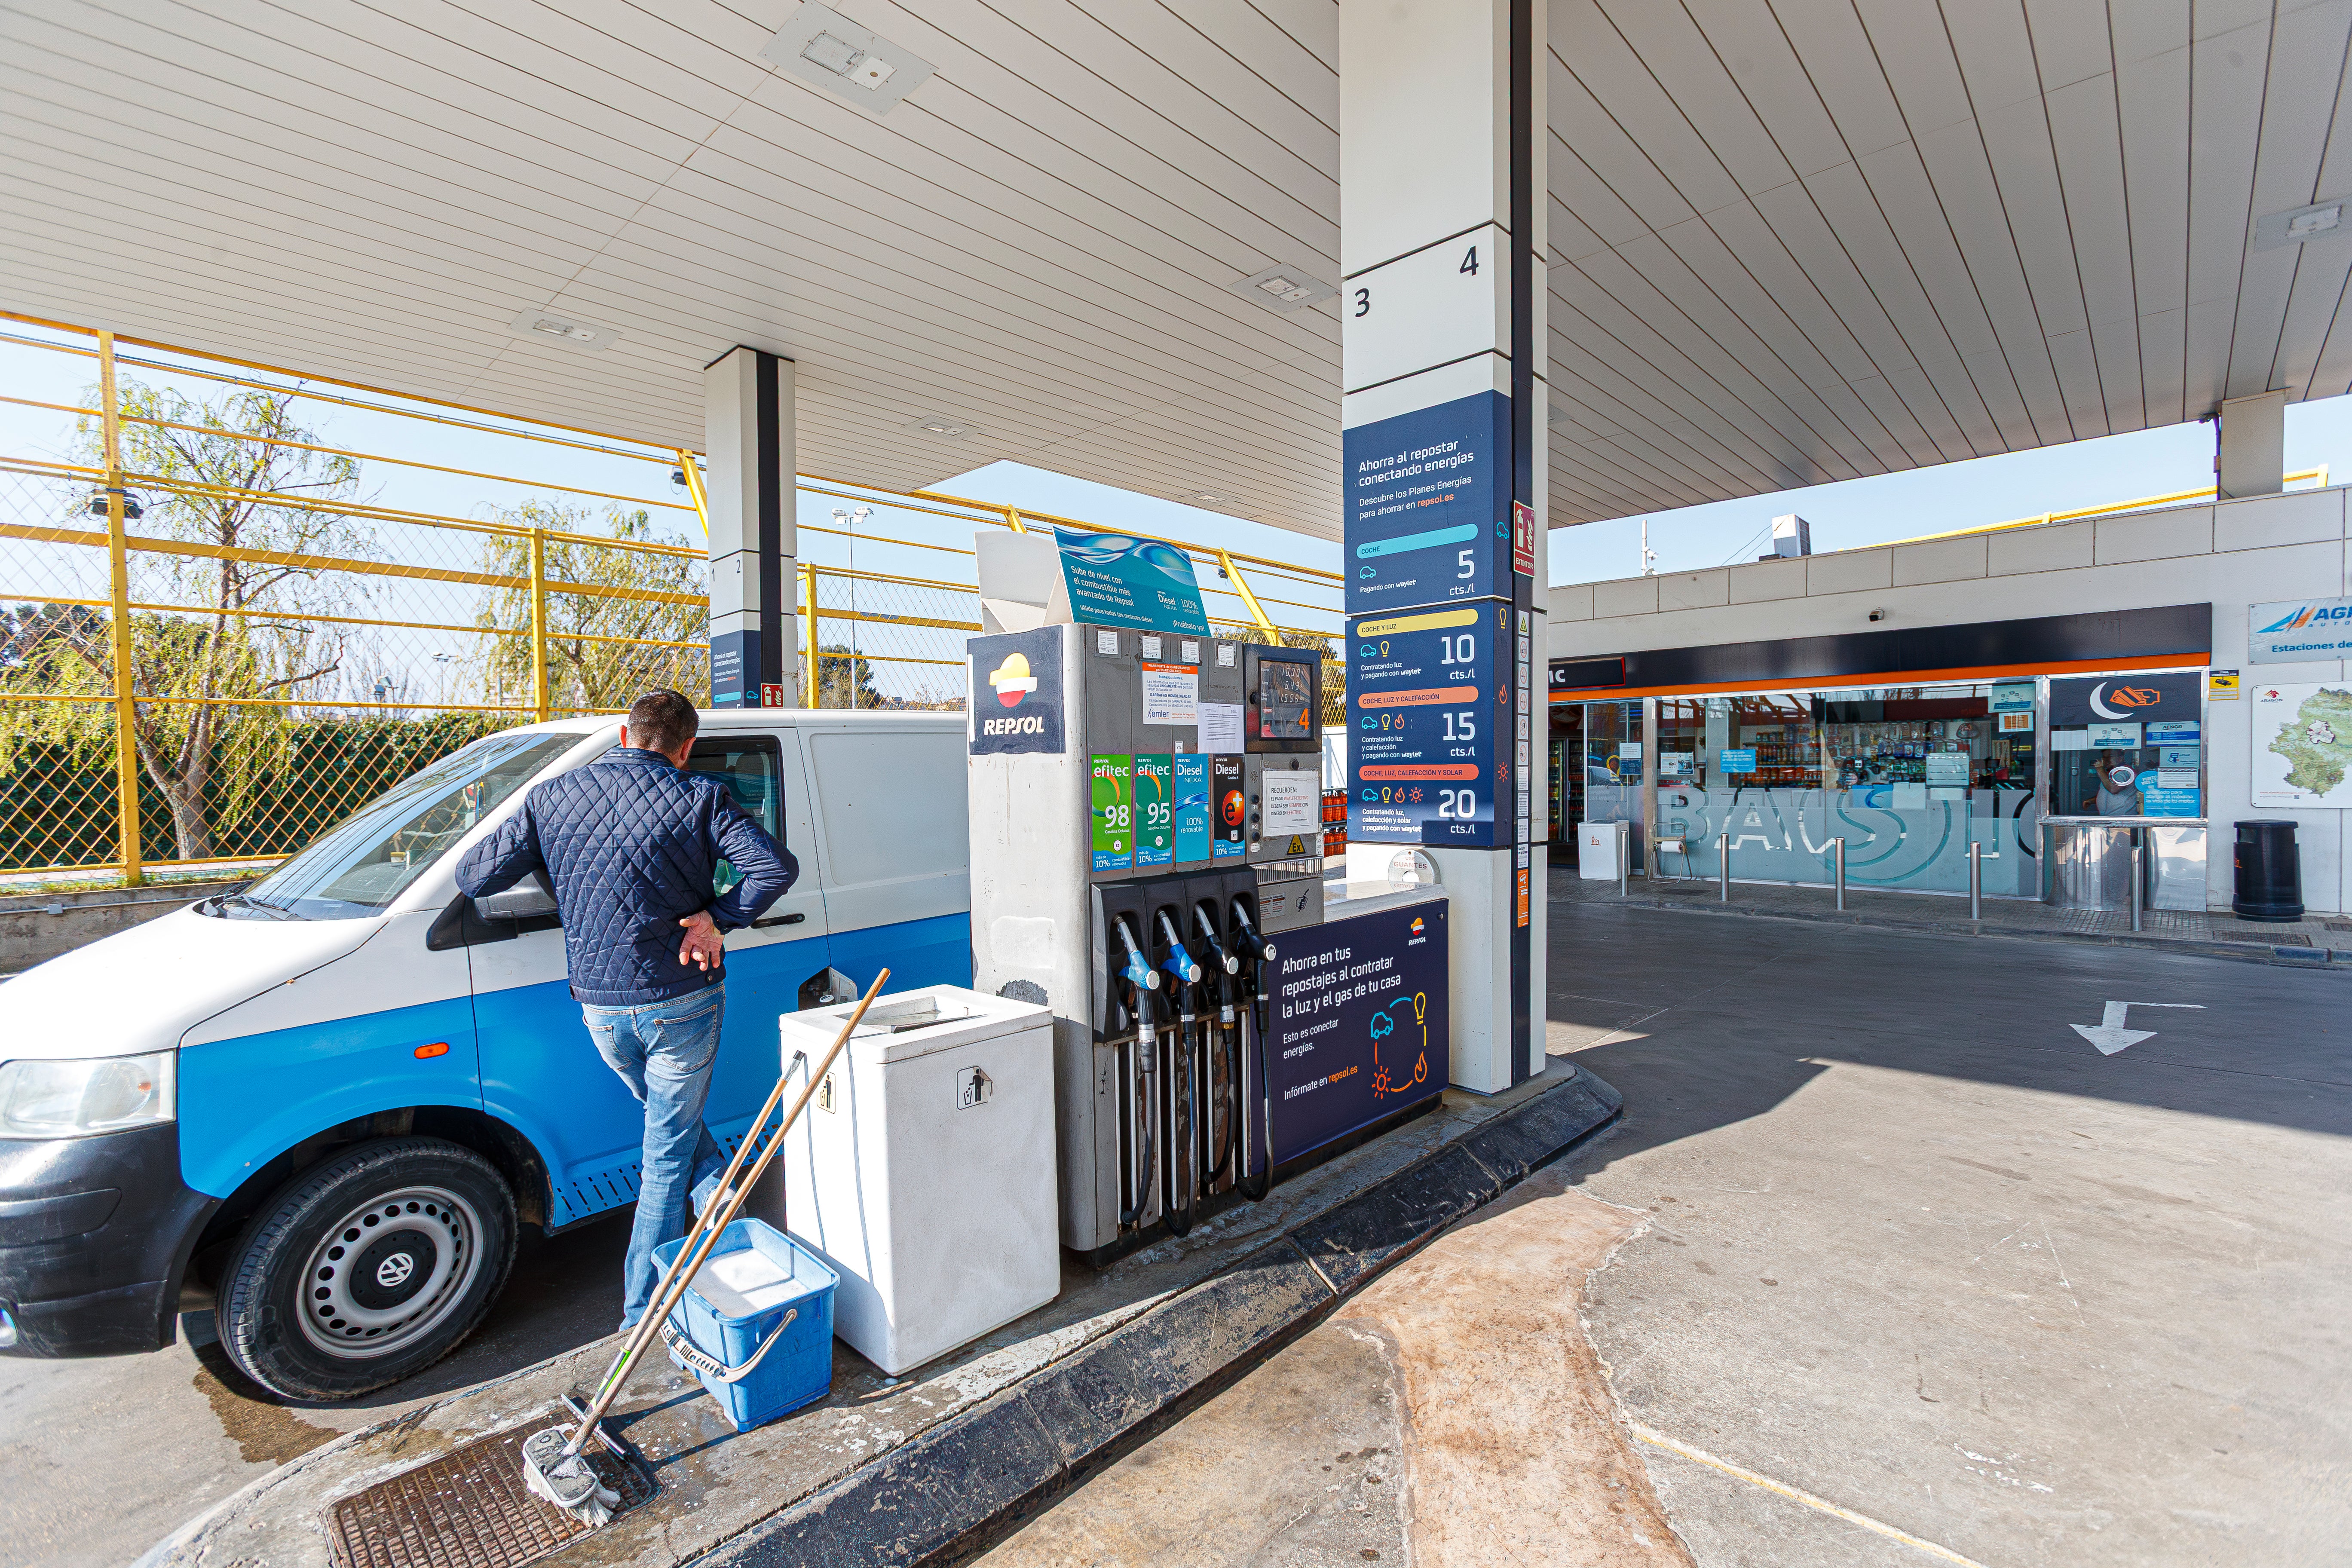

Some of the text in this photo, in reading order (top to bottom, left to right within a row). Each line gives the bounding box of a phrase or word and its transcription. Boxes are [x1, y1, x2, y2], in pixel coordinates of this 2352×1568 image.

[1459, 245, 1479, 276] 4
[1355, 288, 1370, 318] 3
[1359, 441, 1458, 472] Ahorra al repostar
[1359, 450, 1474, 487] conectando energías
[1359, 475, 1472, 506] Descubre los Planes Energías
[1360, 492, 1454, 521] para ahorrar en repsol.es
[1361, 545, 1380, 554] COCHE
[736, 560, 741, 573] 2
[1457, 549, 1475, 579] 5
[1516, 557, 1534, 570] EXTINTOR
[712, 568, 715, 582] 1
[1071, 565, 1087, 576] Sube
[1087, 568, 1095, 578] de
[1096, 571, 1111, 582] nivel
[1074, 576, 1131, 596] el combustible más
[1360, 584, 1383, 594] Pagando
[1395, 579, 1417, 589] waylet
[1449, 583, 1475, 596] cts./l
[1076, 588, 1135, 607] avanzado de Repsol
[1158, 594, 1198, 609] Diesel 100%
[1079, 604, 1093, 612] Válido
[1173, 620, 1197, 631] ¡Pruébalo
[1362, 625, 1380, 633] COCHE
[1441, 634, 1475, 665] 10
[2272, 640, 2352, 652] Estaciones de
[1361, 662, 1393, 671] Contratando
[1365, 670, 1388, 679] pagando
[1400, 668, 1421, 677] waylet
[1450, 668, 1475, 680] cts./l
[1400, 692, 1439, 702] CALEFACCIÓN
[983, 716, 1044, 735] REPSOL
[1299, 708, 1309, 730] 4
[1443, 712, 1475, 741] 15
[1450, 747, 1475, 757] cts./l
[1094, 765, 1129, 777] efitec
[1138, 764, 1170, 775] efitec
[1177, 764, 1202, 776] Diesel
[1216, 763, 1239, 775] Diesel
[1397, 767, 1436, 776] CALEFACCIÓN
[1439, 790, 1476, 818] 20
[1105, 805, 1129, 828] 98
[1148, 802, 1170, 824] 95
[1186, 817, 1203, 826] 100%
[1451, 824, 1475, 834] cts./l
[1292, 842, 1301, 852] Ex
[1096, 859, 1110, 868] 10%
[1139, 855, 1152, 863] 10%
[1408, 936, 1426, 946] REPSOL
[1282, 947, 1351, 975] Ahorra en tus
[1282, 956, 1394, 997] repostajes al contratar
[1282, 974, 1401, 1019] la luz y el gas de tu casa
[1283, 1018, 1339, 1044] Esto es conectar
[1283, 1041, 1315, 1059] energías.
[1284, 1064, 1358, 1100] Infórmate en repsol.es
